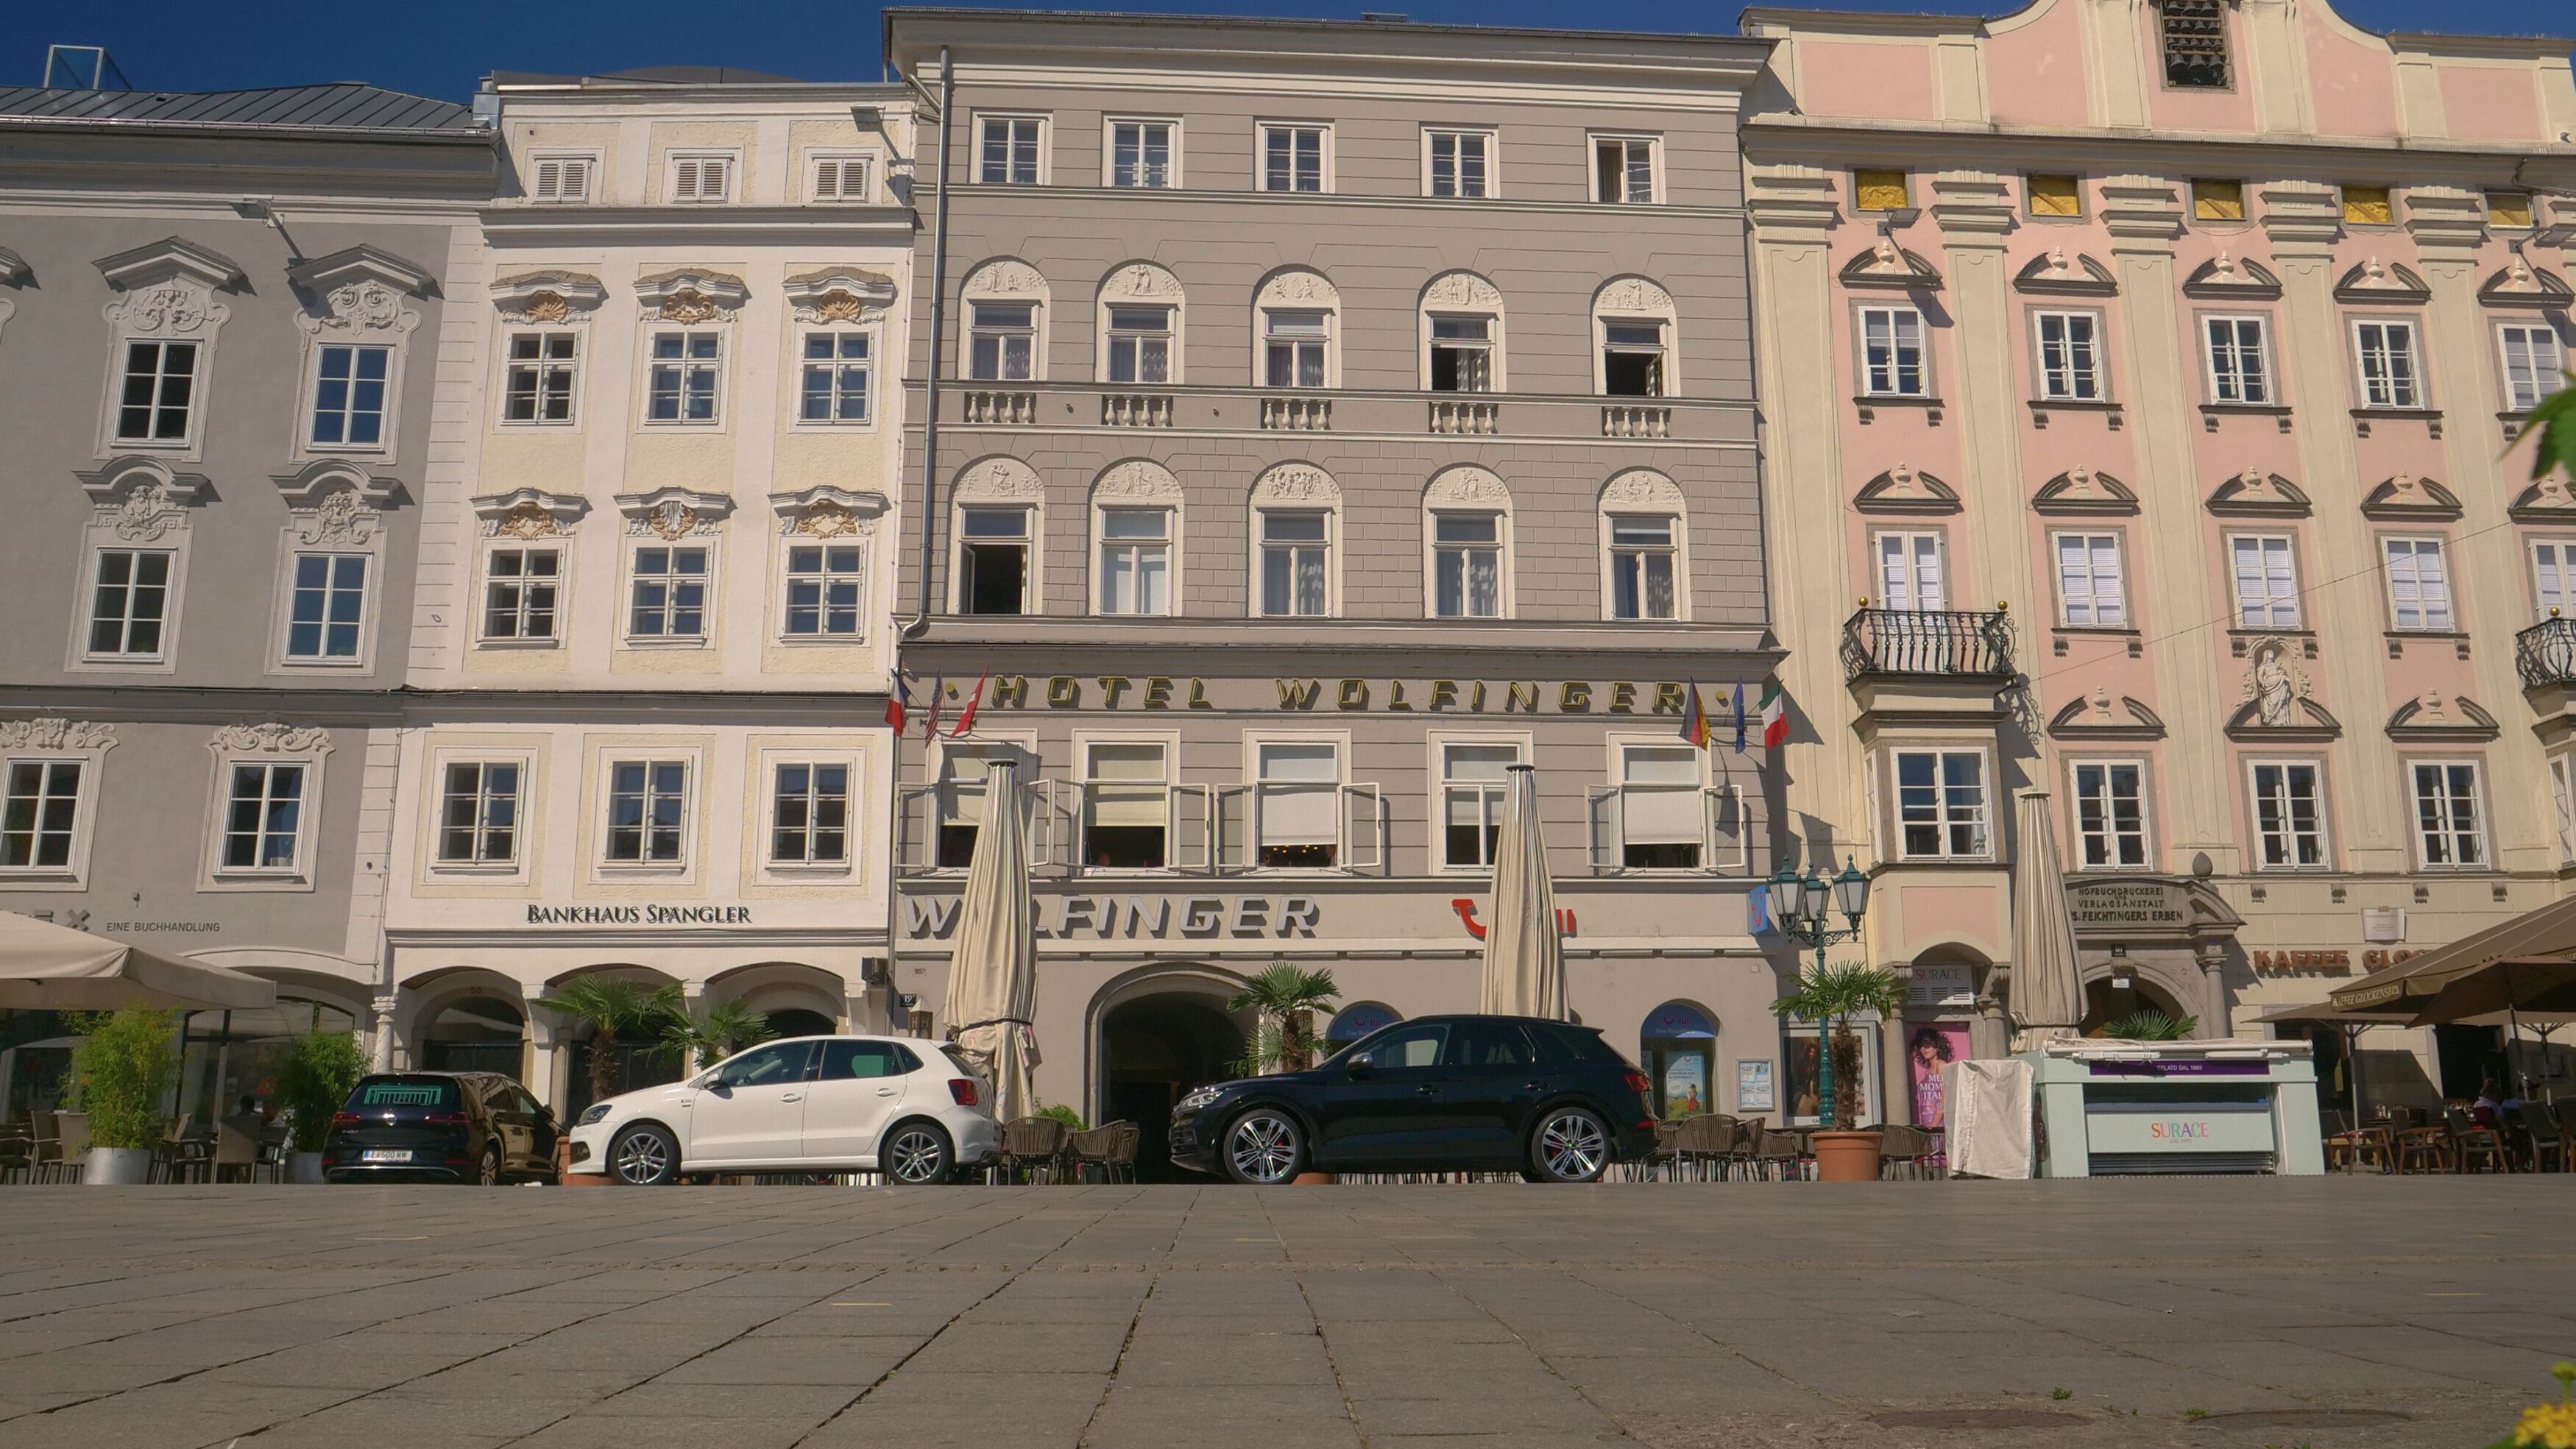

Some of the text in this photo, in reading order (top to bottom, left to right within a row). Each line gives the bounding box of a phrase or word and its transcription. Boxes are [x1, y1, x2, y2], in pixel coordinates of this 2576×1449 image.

[991, 674, 1684, 709] HOTEL WOLFINGER
[2078, 887, 2164, 896] HOFBUCHDRUCKEREI
[2078, 900, 2165, 908] VERLAGSANSTALT
[527, 904, 752, 923] BANKHAUS SPÄNGLER
[902, 895, 1317, 932] WFINGER
[2082, 910, 2148, 921] FEICHTINGERS
[2152, 911, 2184, 921] ERBEN
[106, 922, 221, 932] EINE BUCHHANDLUNG
[2253, 950, 2351, 968] KAFFEE
[1915, 968, 1961, 981] SURACE
[904, 994, 913, 1003] 19
[2151, 1122, 2209, 1138] SURACE
